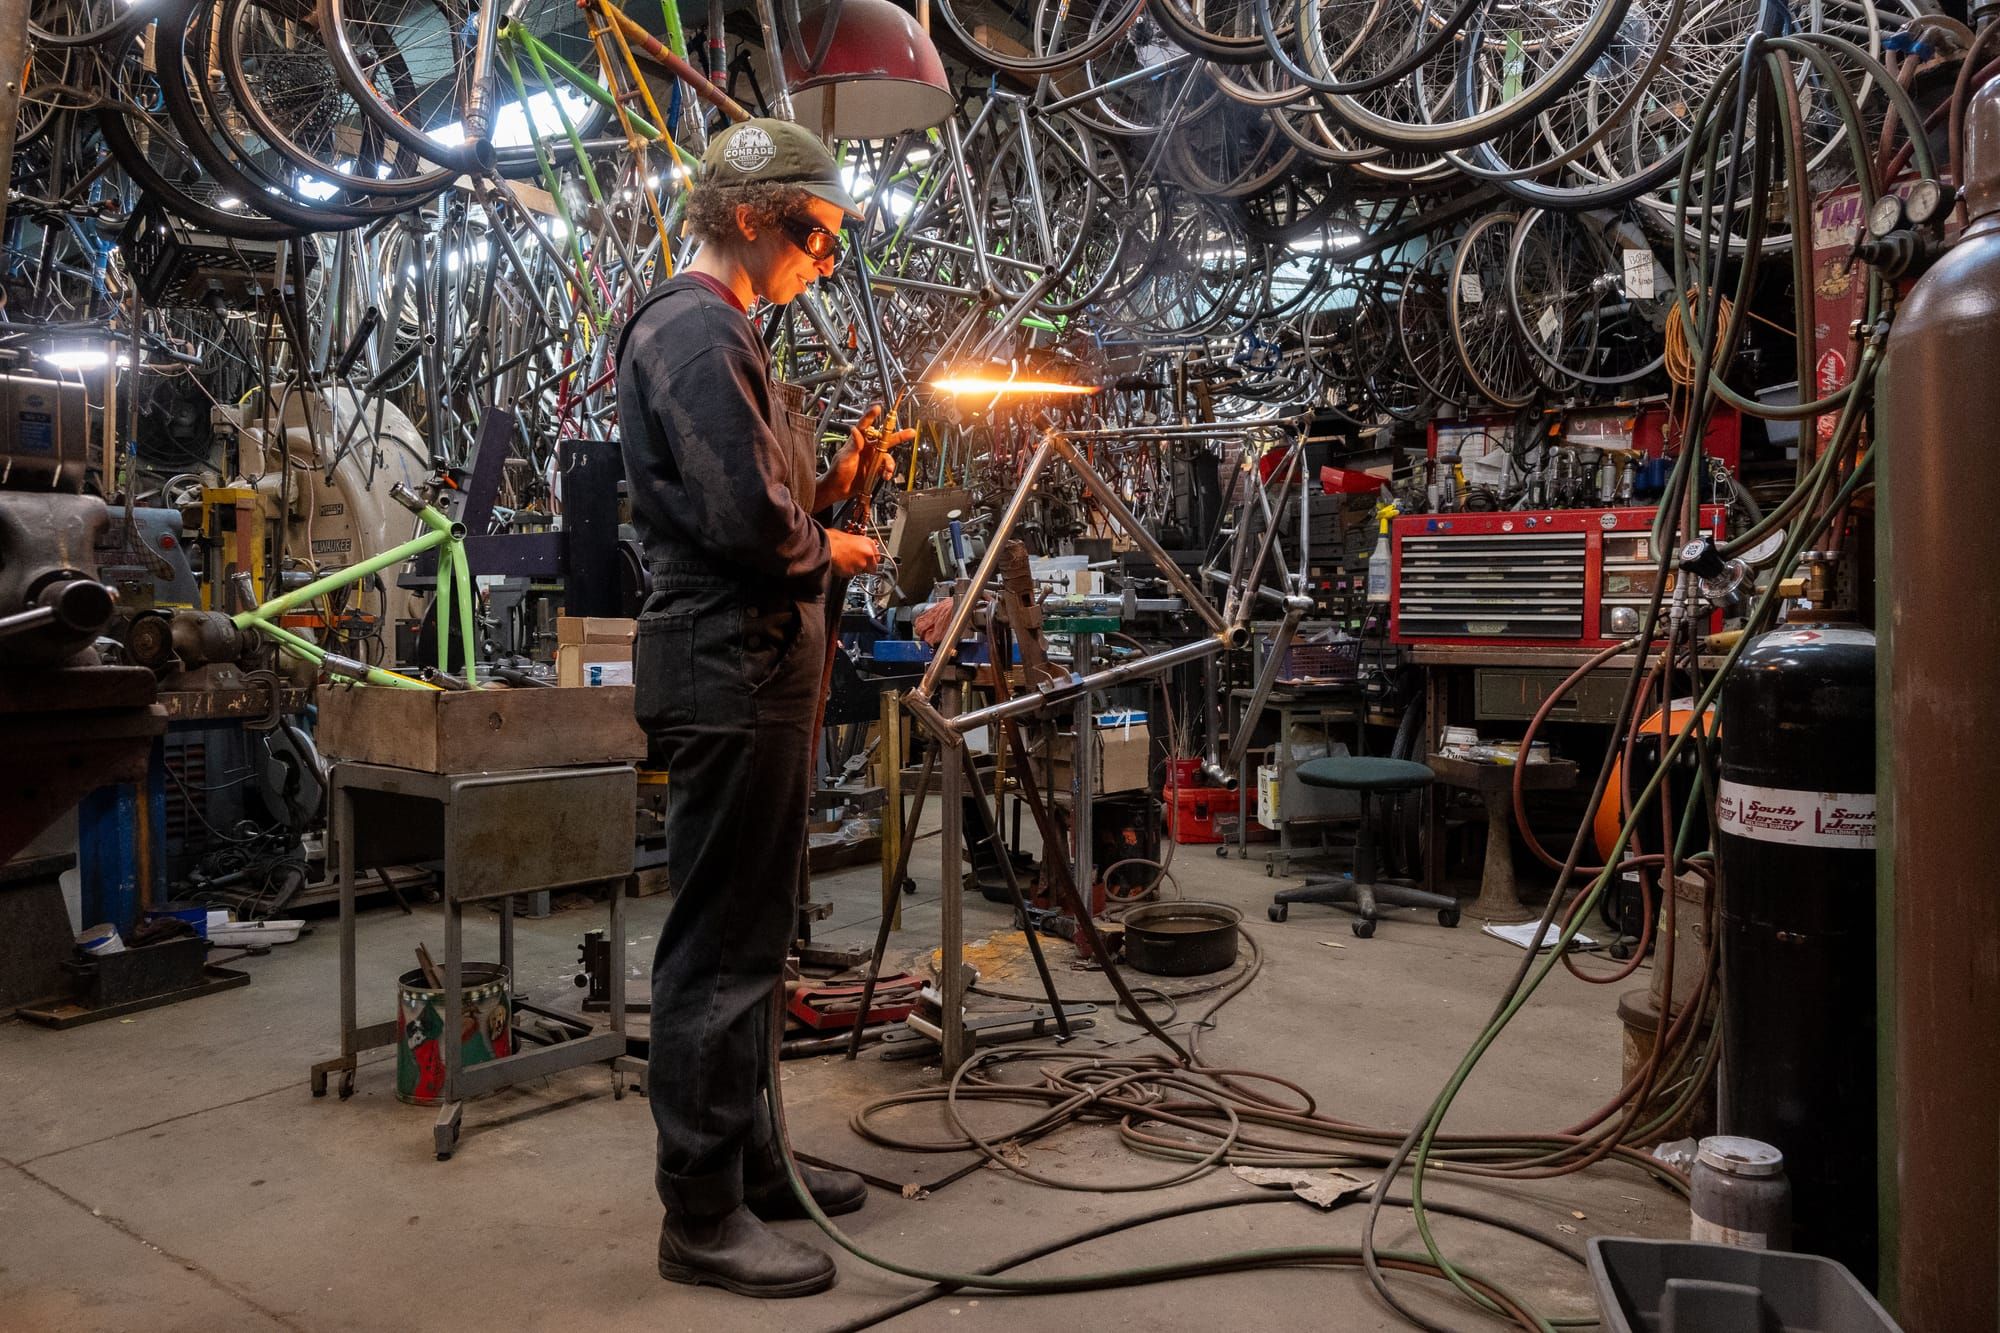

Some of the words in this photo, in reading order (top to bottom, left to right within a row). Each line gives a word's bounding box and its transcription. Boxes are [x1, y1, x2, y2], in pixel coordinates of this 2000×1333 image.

[726, 147, 773, 157] COMRADE
[1749, 801, 1796, 816] South
[1831, 808, 1876, 820] Sout
[1746, 812, 1804, 831] Jersey
[1825, 819, 1876, 830] Jers
